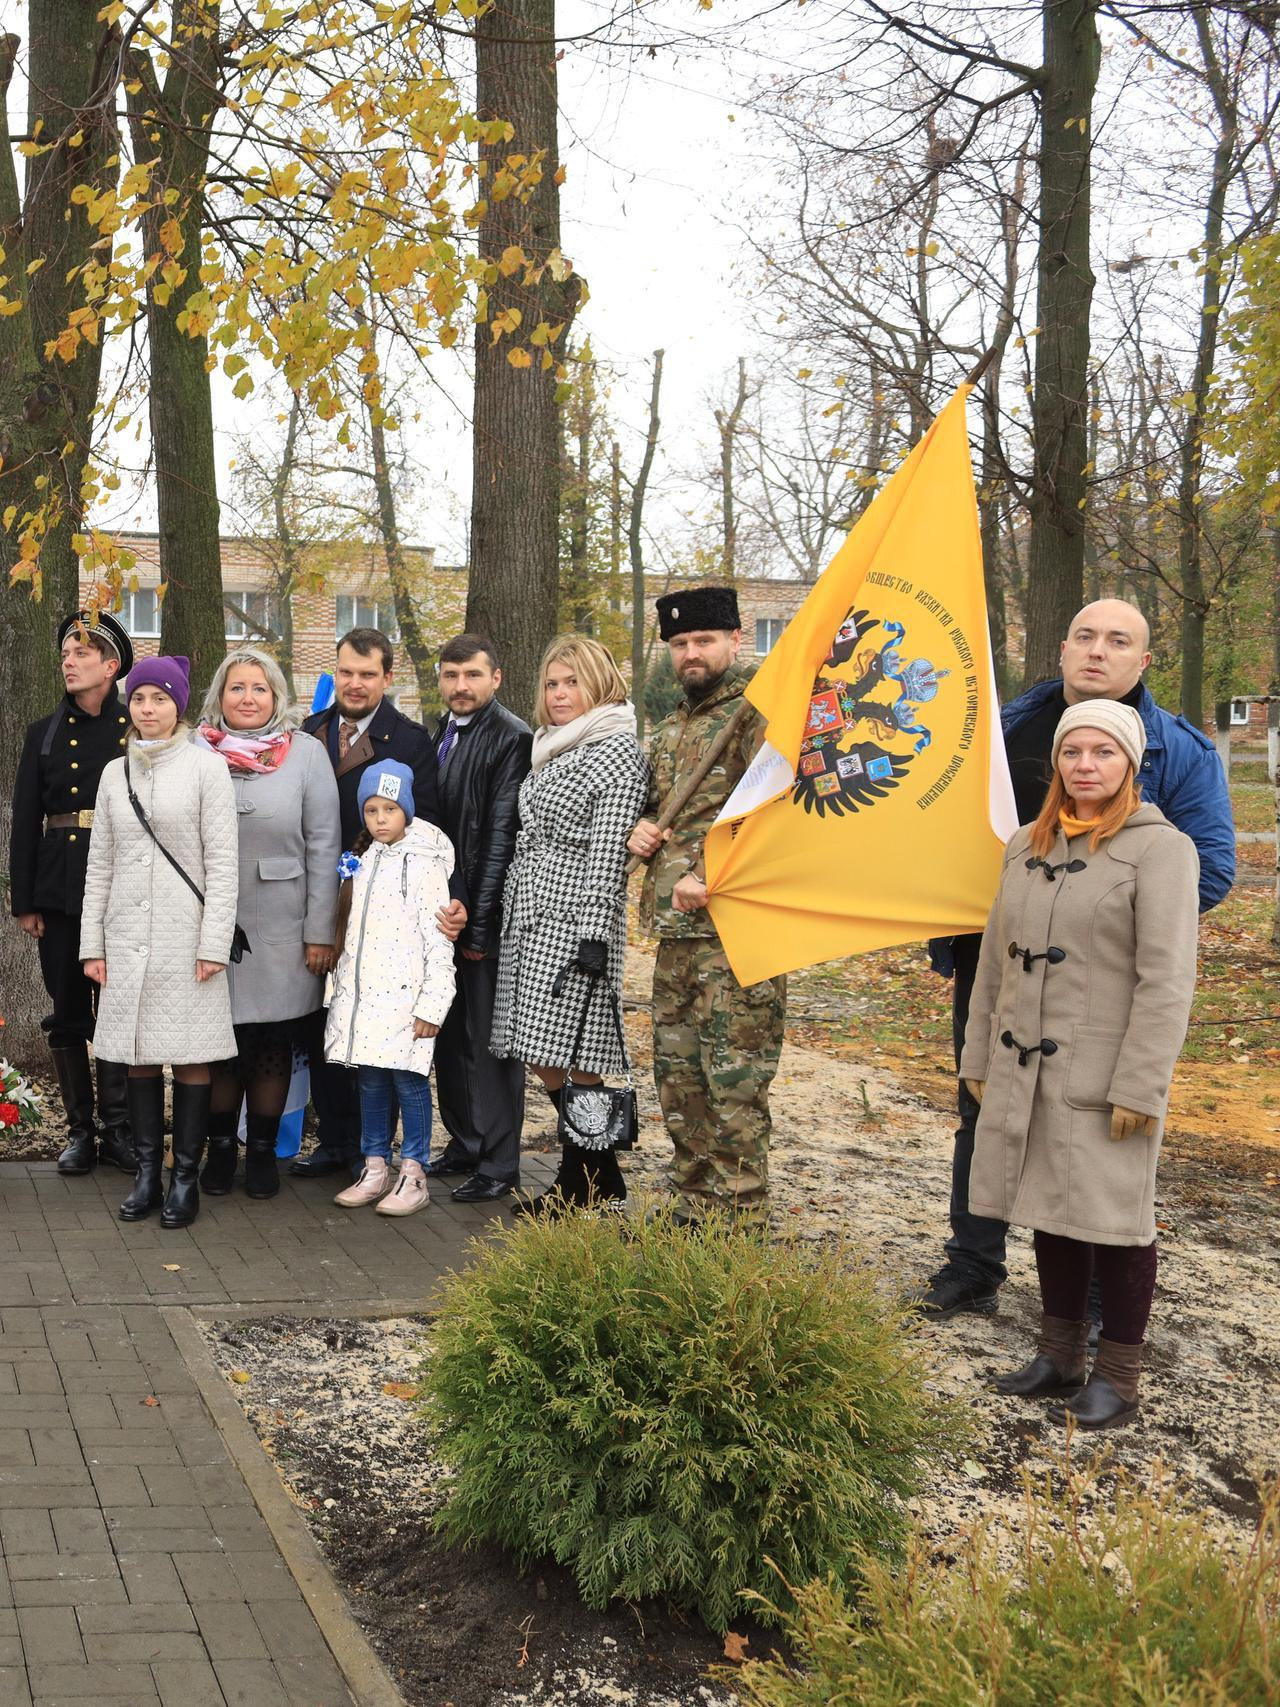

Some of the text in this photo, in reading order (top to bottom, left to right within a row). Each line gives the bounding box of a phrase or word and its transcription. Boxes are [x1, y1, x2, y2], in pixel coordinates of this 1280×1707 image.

[865, 571, 979, 811] ОБЩЕСТВО РАЗВИТИЯ РУССКОГО ИСТОРИЧЕСКОГО ПРОСВЕЩЕНИЯ
